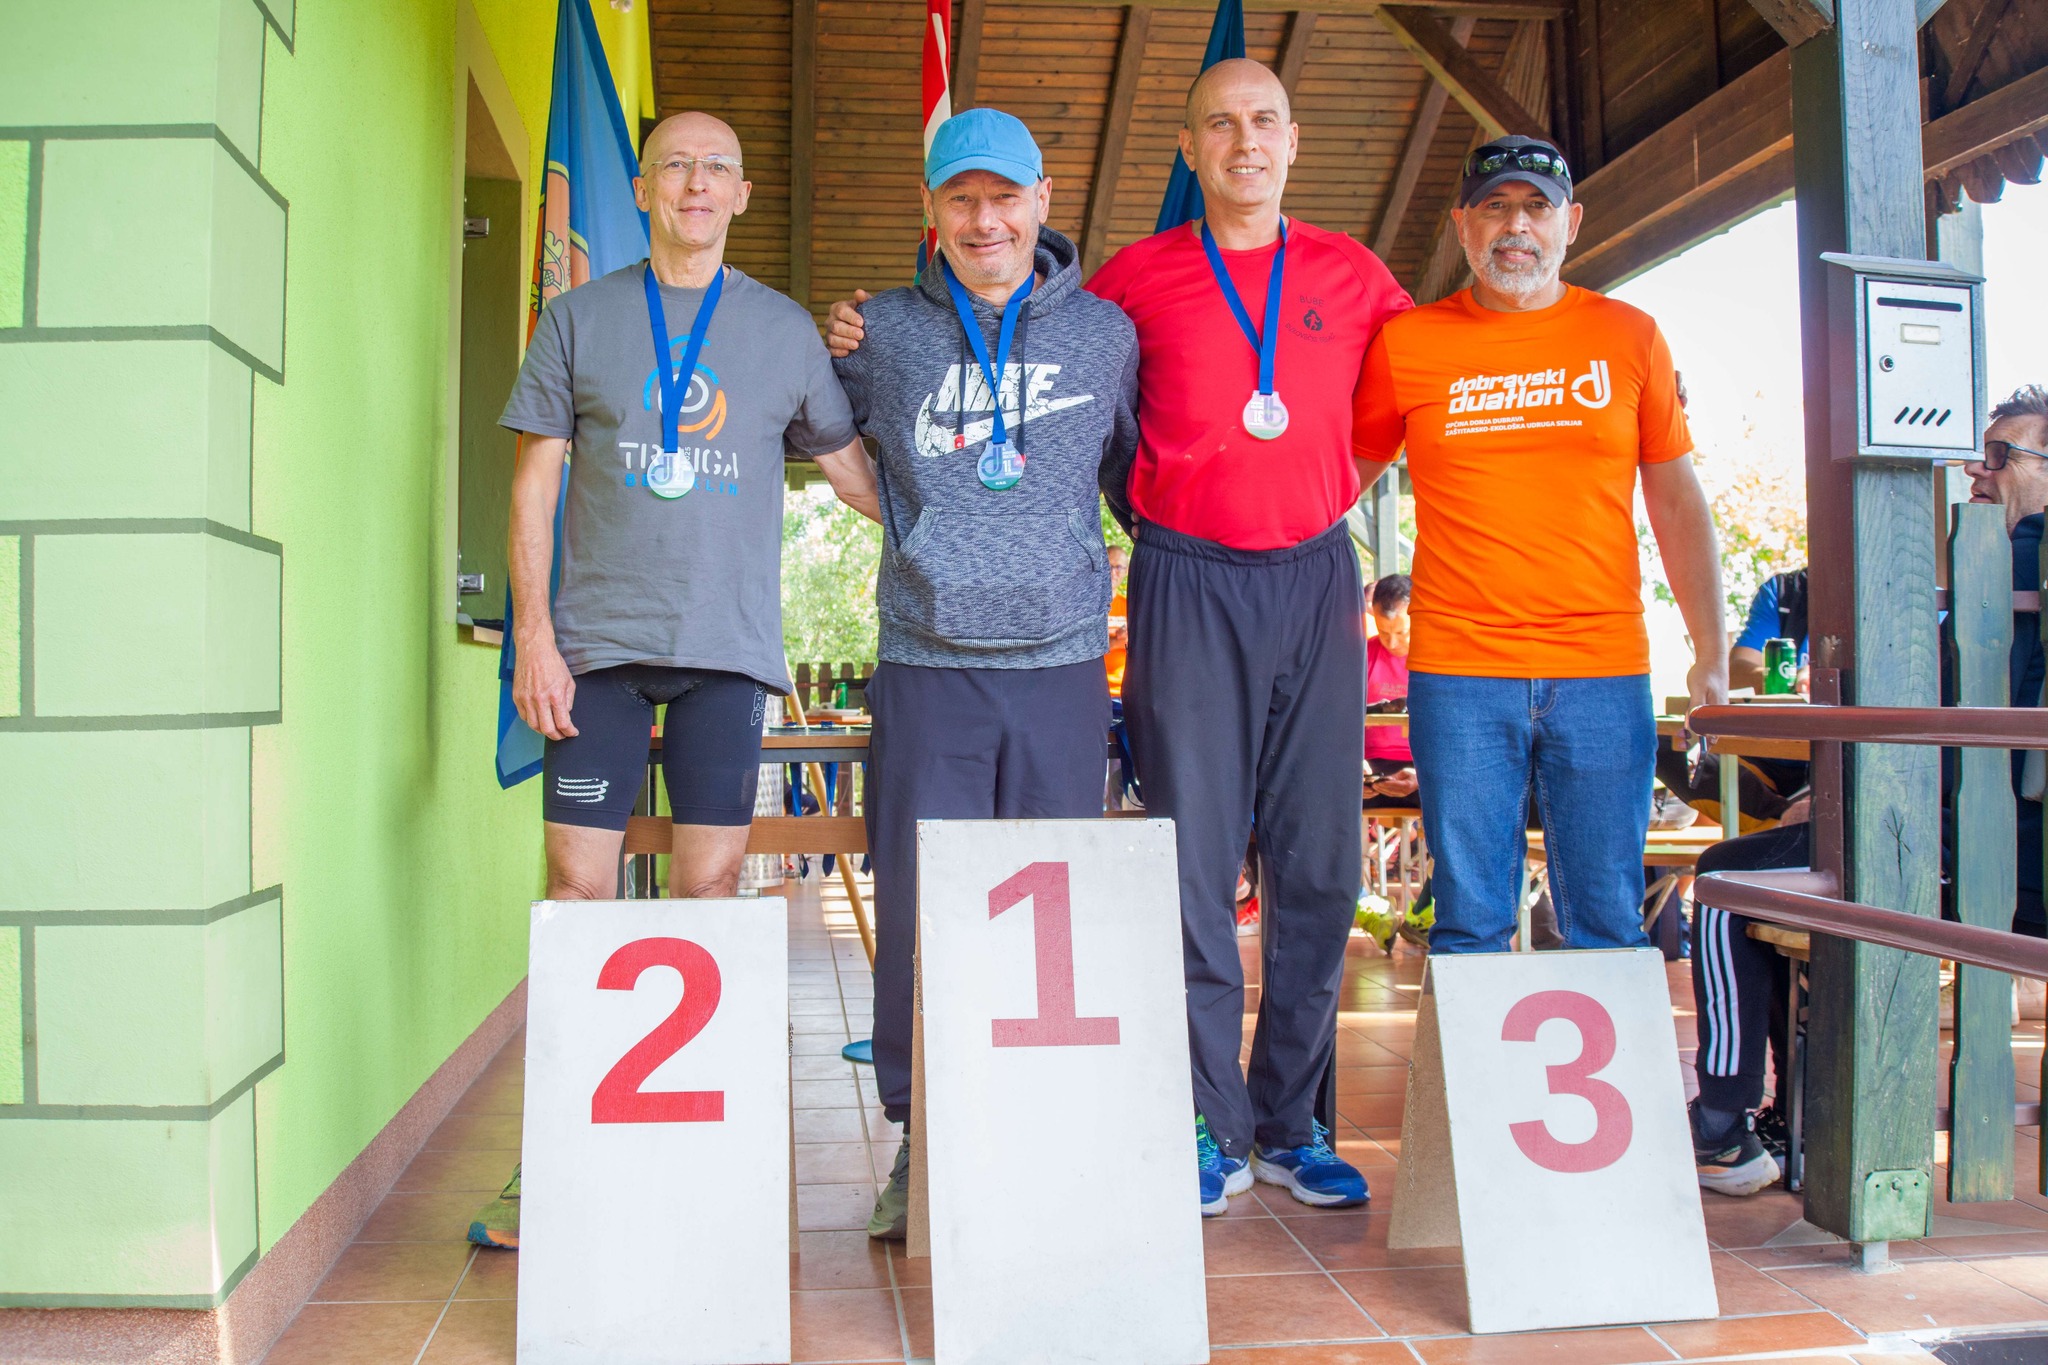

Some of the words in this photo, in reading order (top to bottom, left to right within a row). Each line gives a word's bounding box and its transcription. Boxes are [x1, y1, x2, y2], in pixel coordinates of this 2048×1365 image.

[1300, 295, 1324, 307] BUBE
[933, 363, 1061, 412] NIKE
[1449, 368, 1566, 394] dobravski
[1448, 387, 1564, 414] duatlon
[1470, 418, 1491, 426] DONJA
[1493, 416, 1524, 424] DUBRAVA
[1527, 420, 1555, 429] UDRUGA
[1556, 419, 1582, 427] SENJAR
[989, 862, 1119, 1046] 1
[591, 937, 724, 1124] 2
[1502, 991, 1631, 1172] 3
